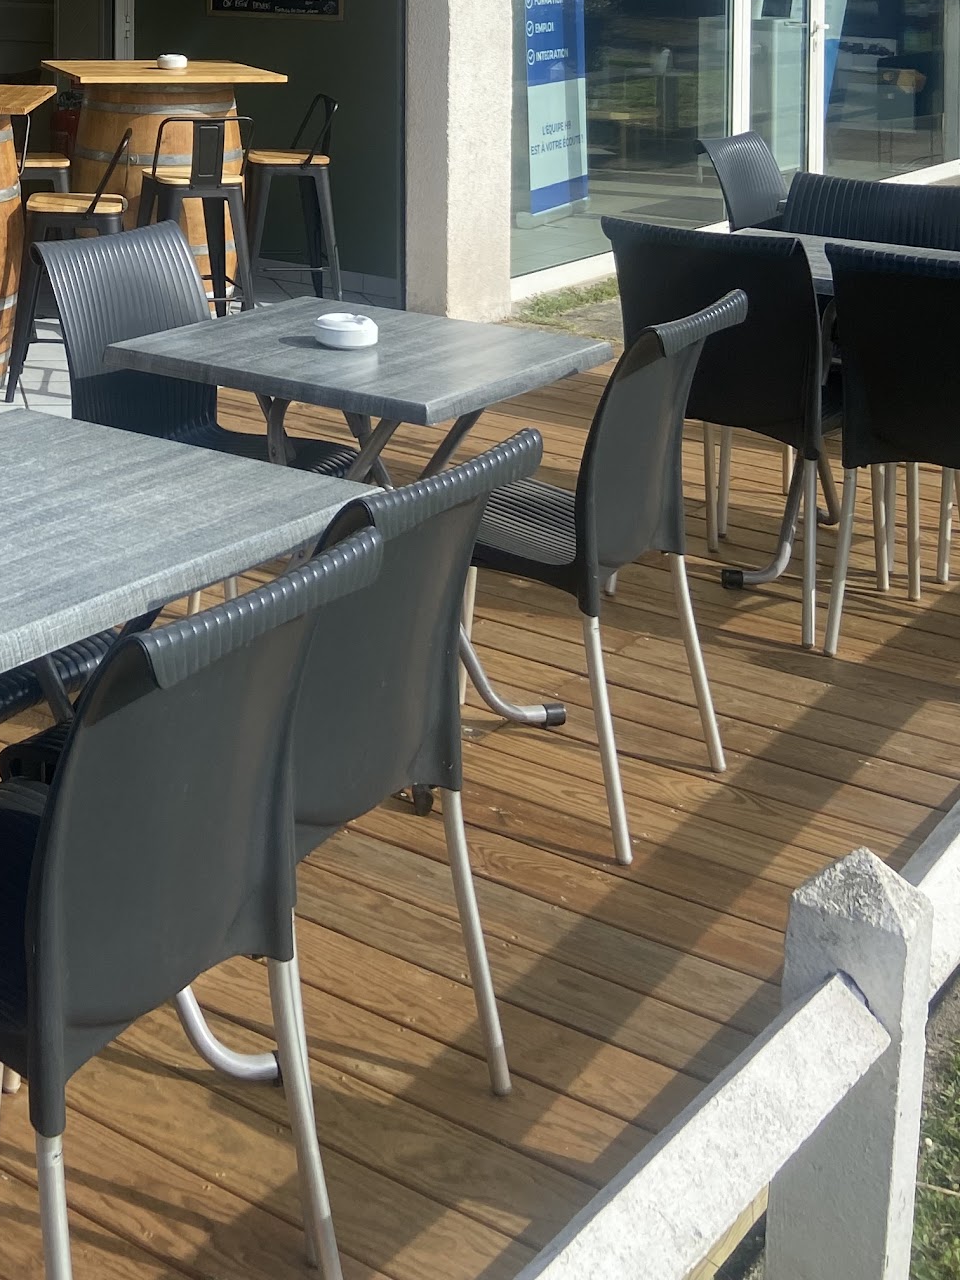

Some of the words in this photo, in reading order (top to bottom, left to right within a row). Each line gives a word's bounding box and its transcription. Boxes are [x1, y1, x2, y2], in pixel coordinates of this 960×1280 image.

[535, 22, 555, 33] EMPLOI
[531, 144, 540, 155] EST
[546, 139, 562, 151] VOTRE
